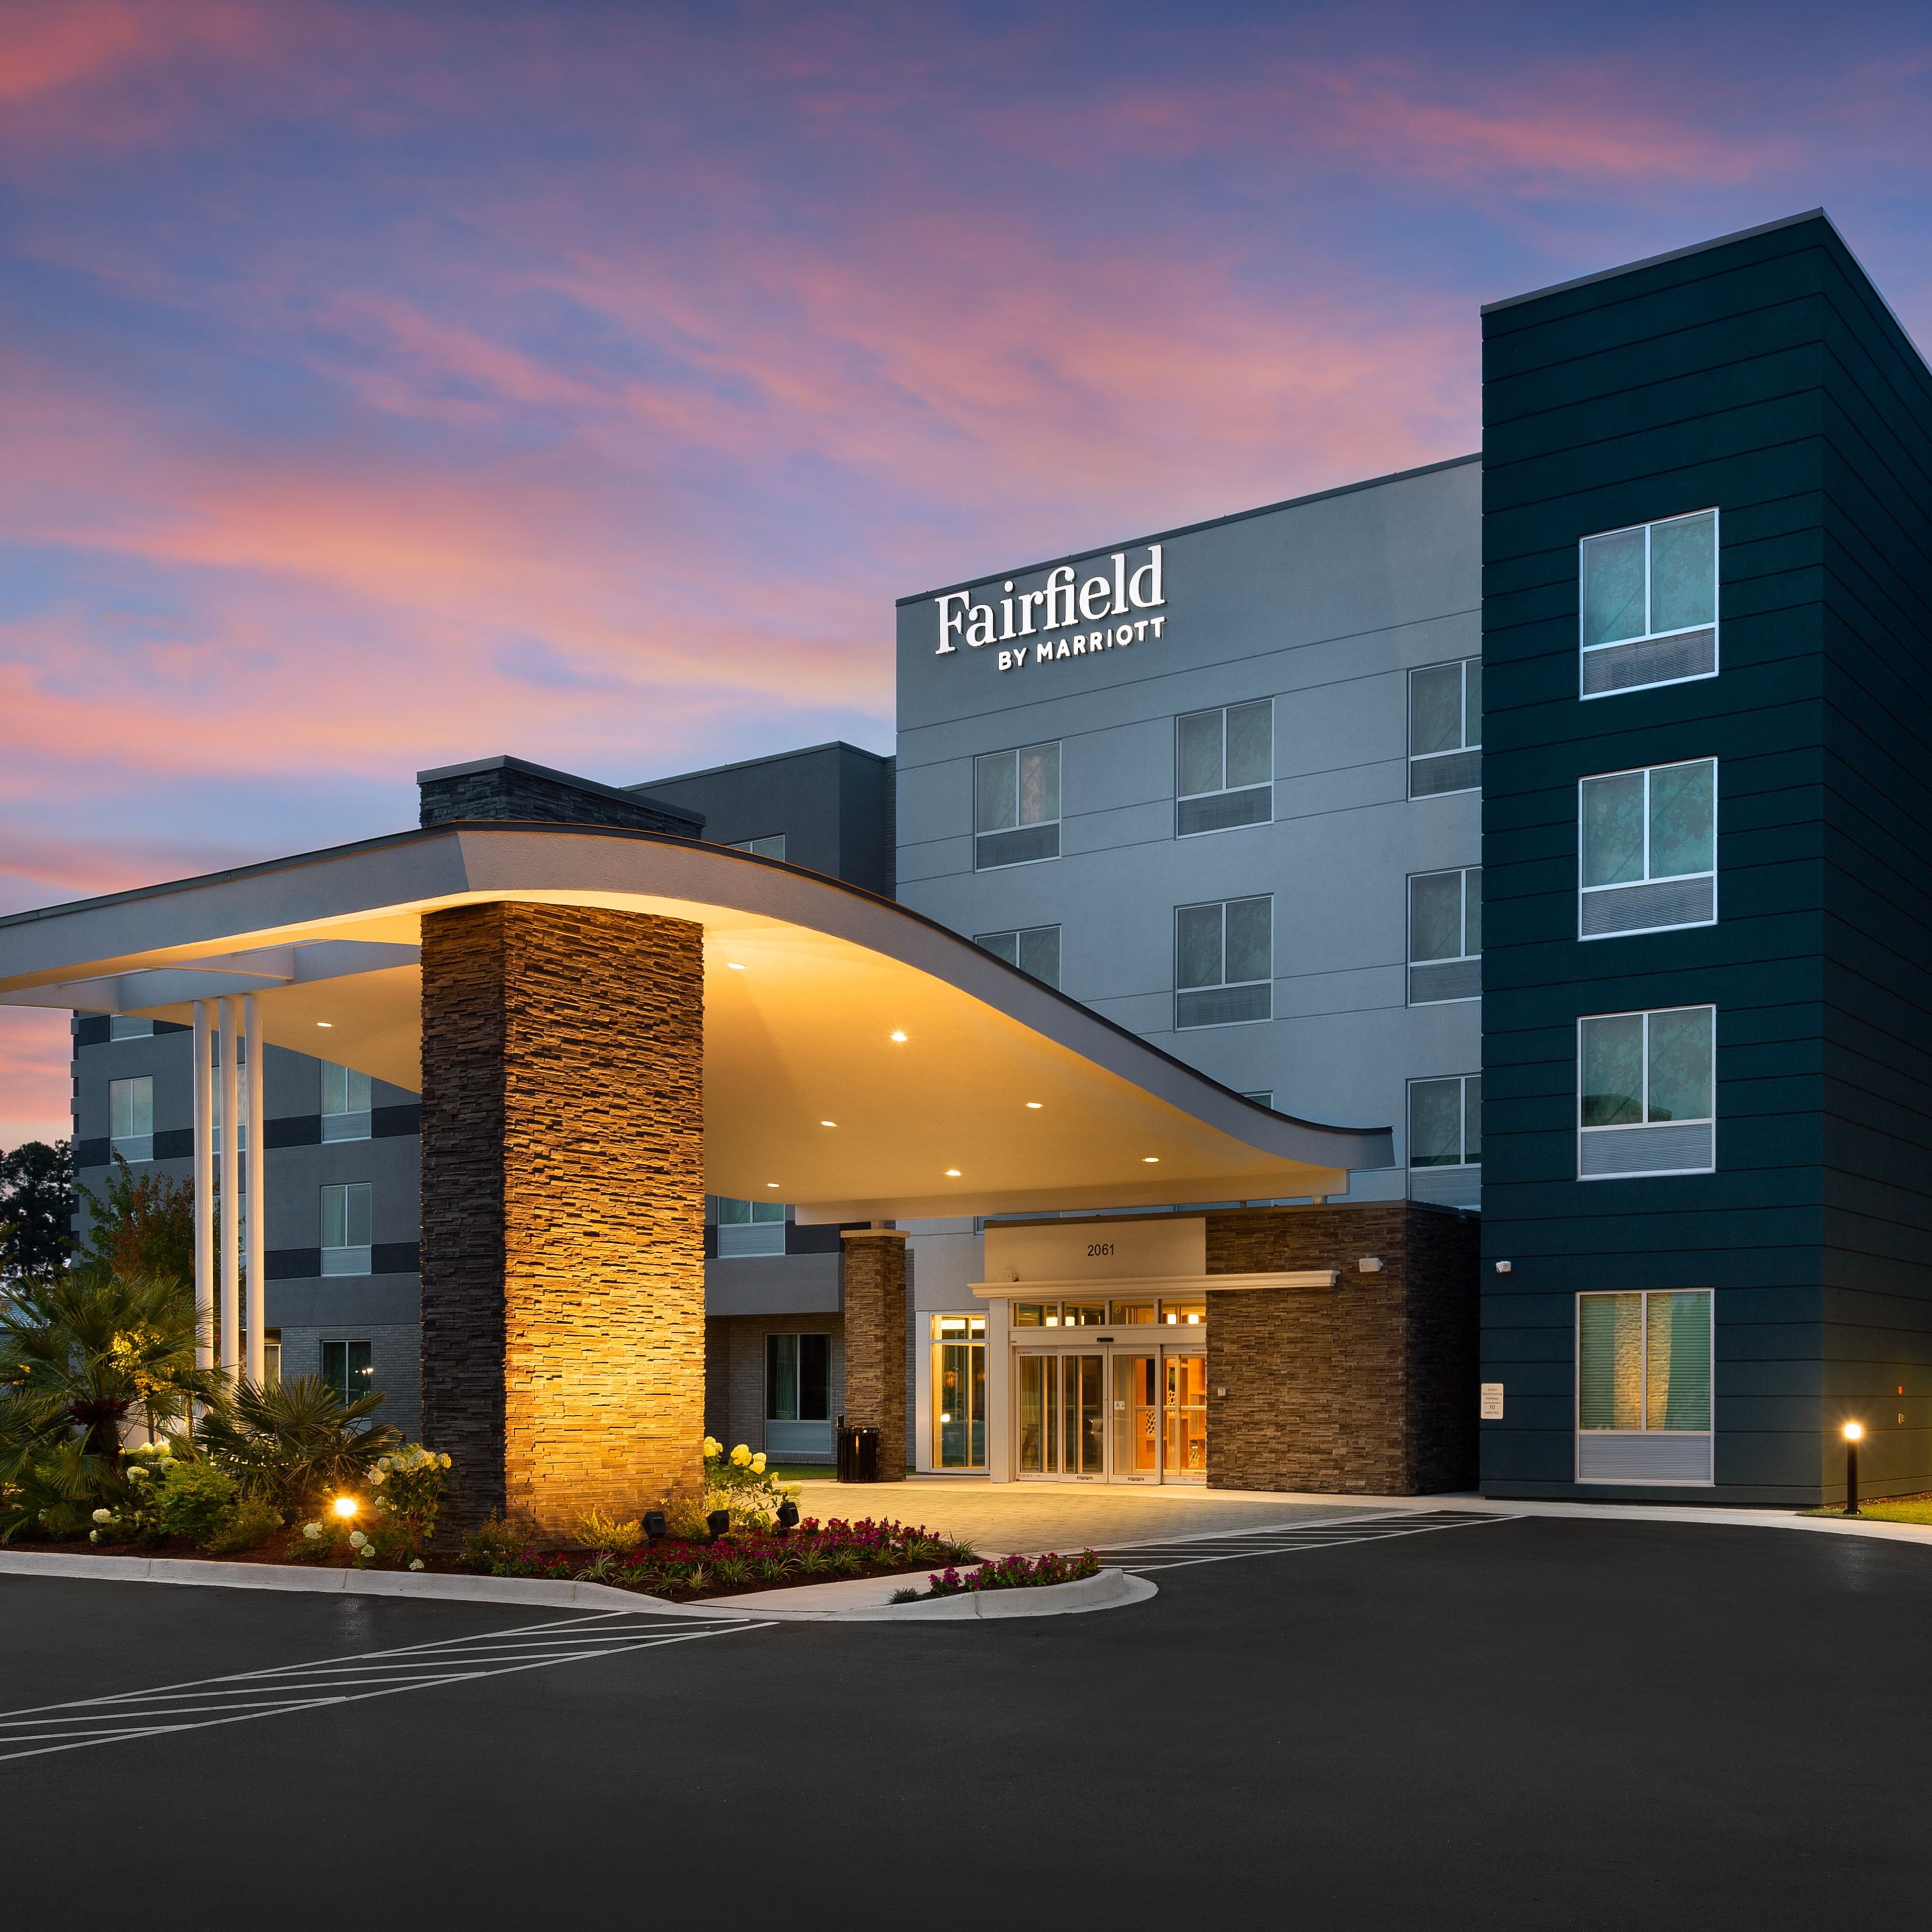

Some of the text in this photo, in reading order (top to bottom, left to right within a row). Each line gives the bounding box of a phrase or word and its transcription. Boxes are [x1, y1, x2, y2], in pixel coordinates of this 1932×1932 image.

[934, 544, 1166, 655] Fairfield
[998, 616, 1166, 671] BY MARRIOTT
[1087, 1243, 1114, 1256] 2061
